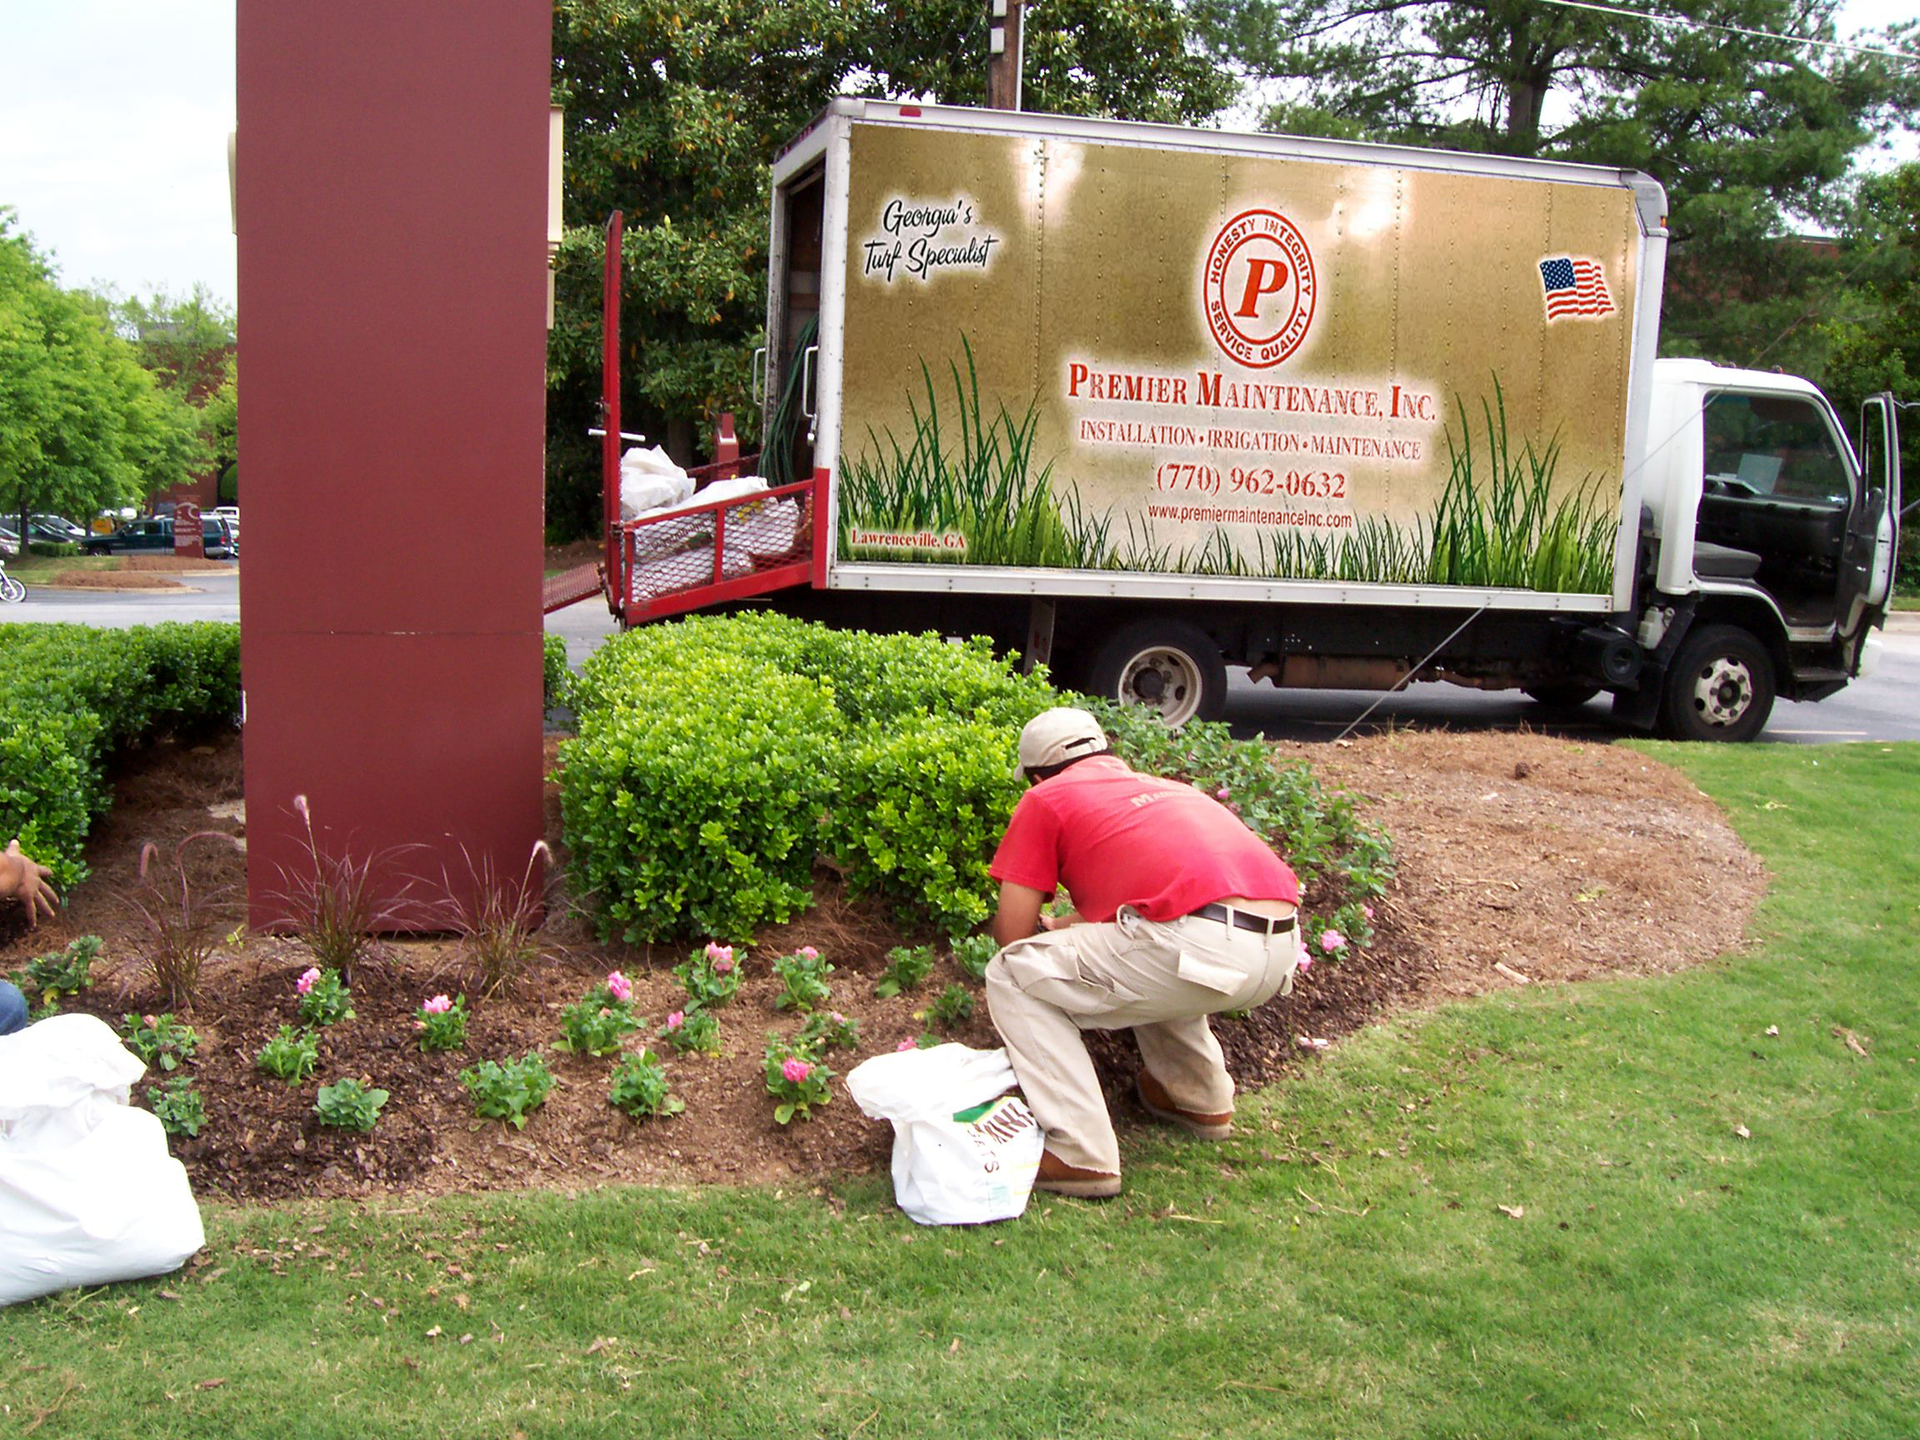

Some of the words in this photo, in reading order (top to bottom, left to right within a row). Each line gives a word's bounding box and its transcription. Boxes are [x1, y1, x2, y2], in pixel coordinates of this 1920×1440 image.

[883, 199, 972, 237] Georgia's
[864, 239, 902, 282] Turf
[905, 234, 1000, 280] Specialist
[1210, 218, 1256, 284] HONESTY
[1264, 218, 1311, 296] INTEGRITY
[1233, 258, 1289, 318] P
[1210, 300, 1253, 360] SERVICE
[1261, 307, 1307, 361] QUALITY
[1068, 362, 1188, 406] PREMIER
[1390, 385, 1436, 421] INC.
[1080, 419, 1196, 446] INSTALLATION
[1207, 428, 1299, 452] IRRIGATION
[1311, 435, 1421, 460] MAINTENANCE
[1157, 463, 1221, 497] (770)
[1230, 466, 1345, 499] 962-0632
[1148, 504, 1352, 528] www.premiermaintenanceinc.com
[943, 533, 965, 548] GA
